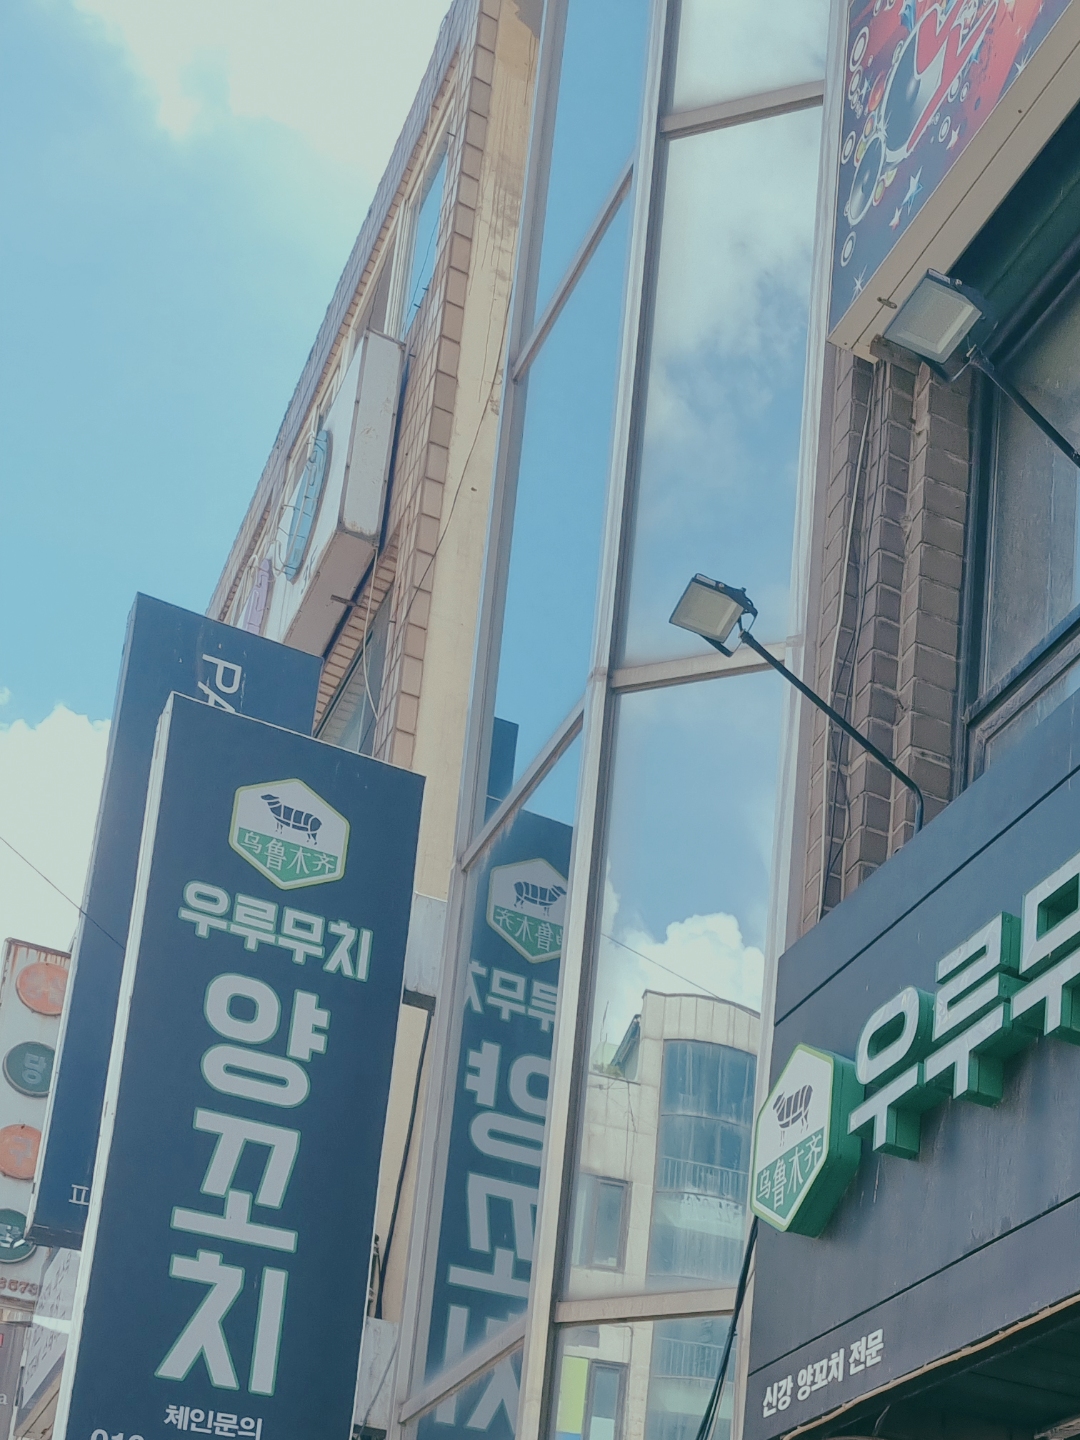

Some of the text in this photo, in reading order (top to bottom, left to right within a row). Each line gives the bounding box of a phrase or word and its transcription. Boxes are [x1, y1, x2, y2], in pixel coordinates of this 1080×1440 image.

[240, 829, 338, 876] 乌鲁木齐
[178, 880, 375, 982] 우루무치
[155, 972, 331, 1396] 양꼬치
[756, 1134, 823, 1212] 乌鲁木齐
[762, 1328, 885, 1418] 신강 양꼬치 전문
